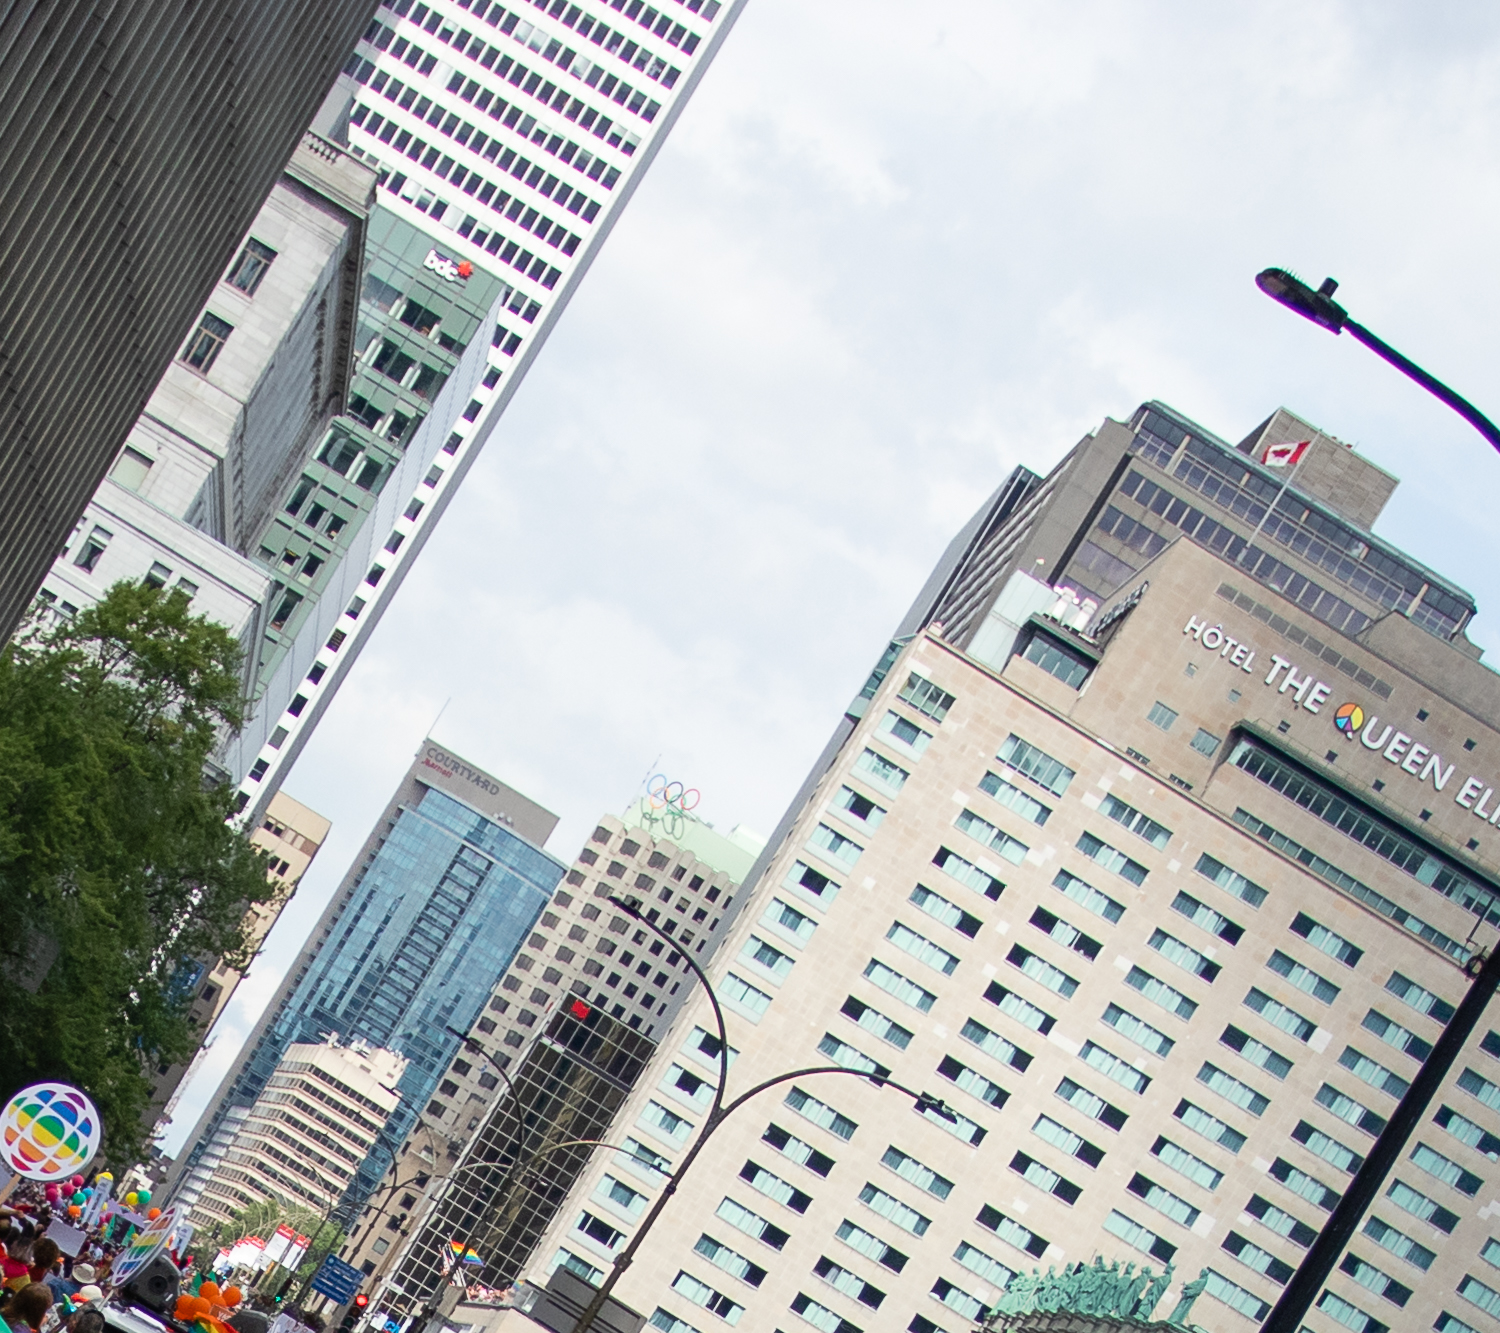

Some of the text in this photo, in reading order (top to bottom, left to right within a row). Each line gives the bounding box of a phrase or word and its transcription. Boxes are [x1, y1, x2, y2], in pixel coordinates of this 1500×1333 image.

[423, 249, 458, 282] bdc
[1183, 614, 1255, 673] HÔTEL
[1264, 654, 1332, 714] THE
[1334, 702, 1455, 791] QUEEN
[427, 747, 500, 796] COURTYARD
